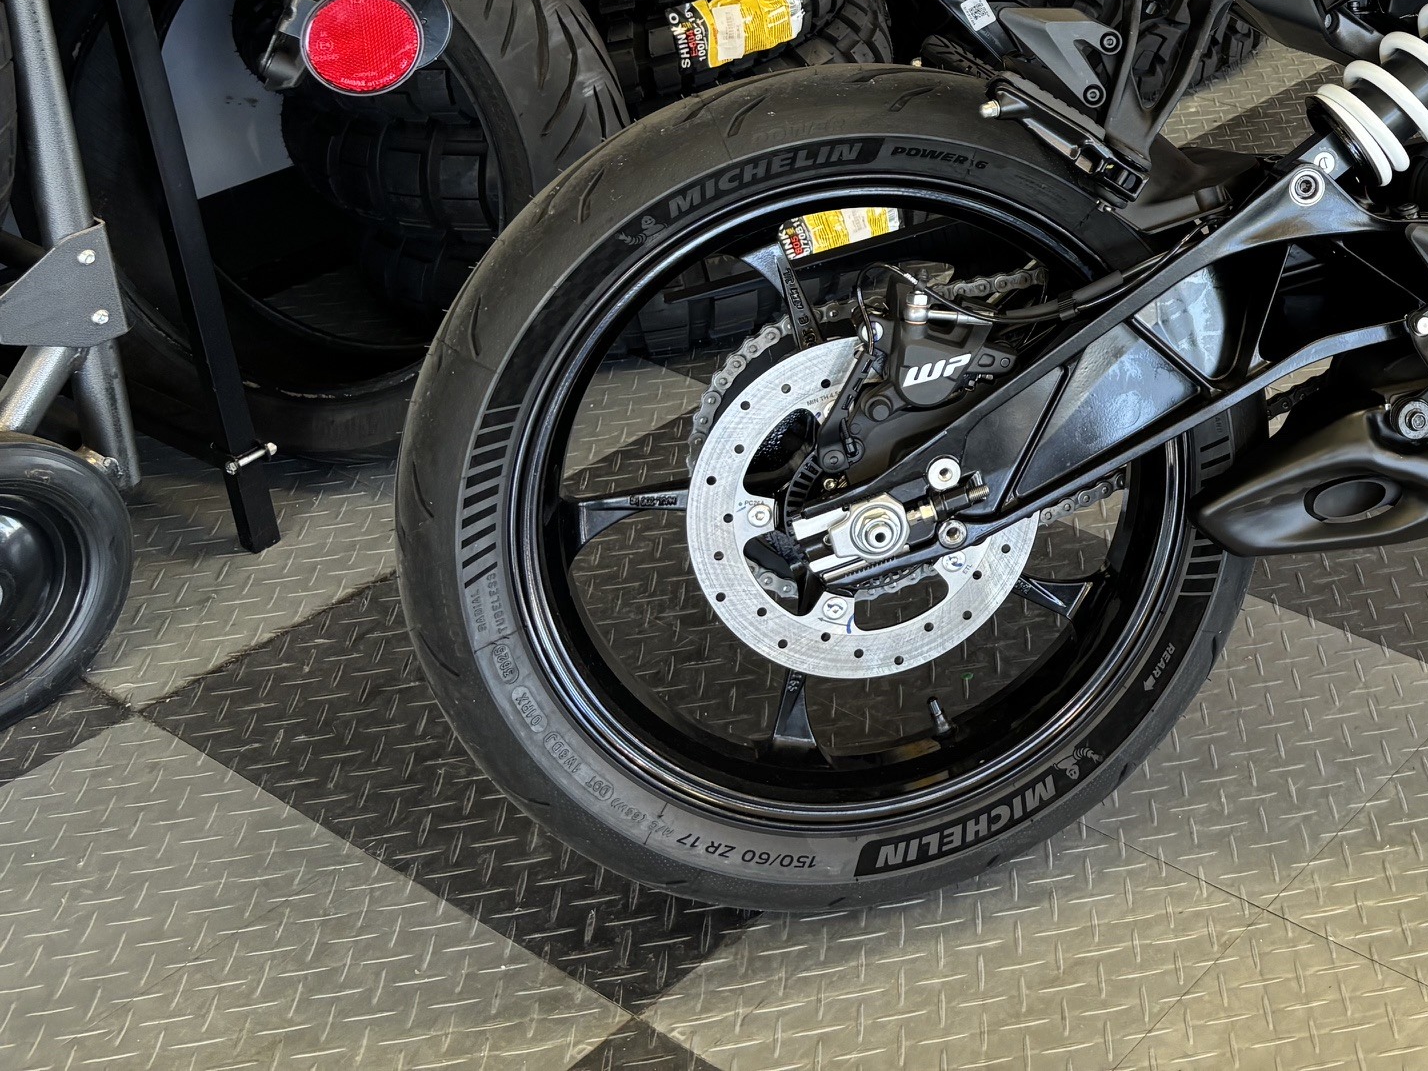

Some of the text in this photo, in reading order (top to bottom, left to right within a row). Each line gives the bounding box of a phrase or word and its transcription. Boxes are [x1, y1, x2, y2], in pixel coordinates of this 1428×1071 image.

[668, 12, 692, 69] SHINKO
[890, 146, 989, 170] POWER 6
[668, 143, 863, 219] MICHELIN
[903, 353, 972, 387] WP
[470, 589, 488, 633] RADIAL
[486, 572, 510, 634] TUBELESS
[1152, 642, 1176, 679] REAR
[876, 774, 1056, 868] MICHELIN
[676, 833, 700, 848] 17
[705, 840, 737, 859] ZR
[741, 848, 817, 869] 150/60
